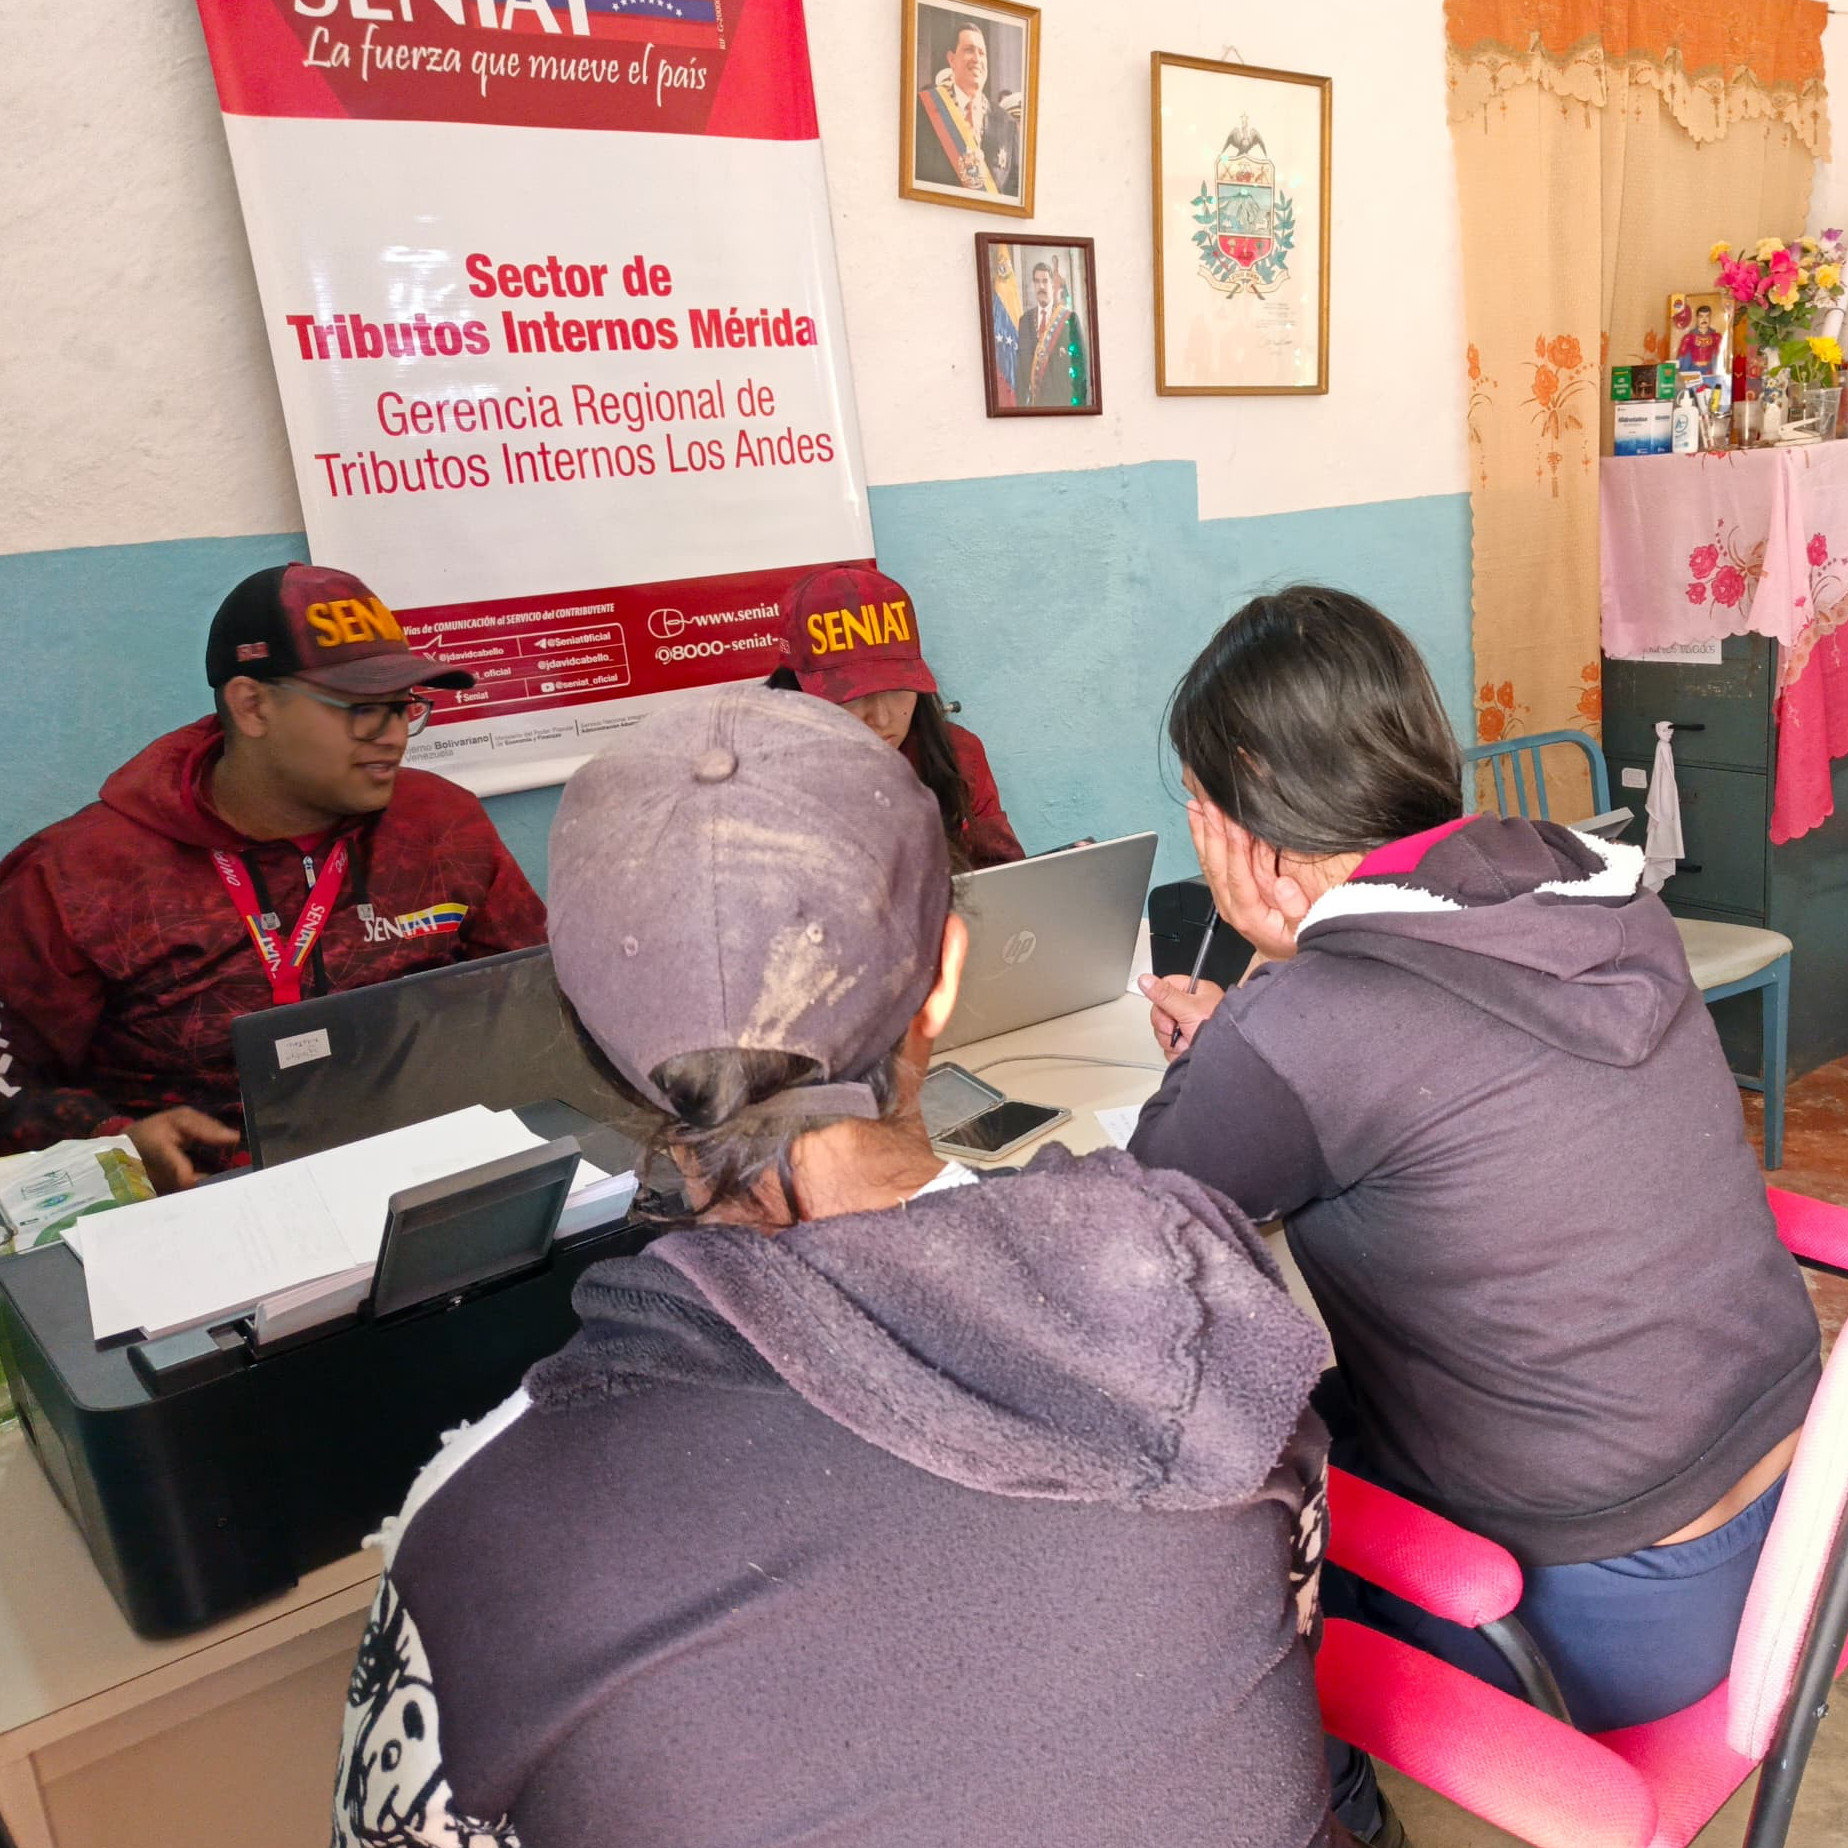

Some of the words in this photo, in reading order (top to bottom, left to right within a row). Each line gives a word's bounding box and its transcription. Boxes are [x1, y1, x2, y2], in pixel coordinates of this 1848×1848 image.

[302, 26, 351, 68] La
[361, 23, 461, 82] fuerza
[471, 51, 520, 97] que
[528, 55, 619, 84] mueve
[628, 43, 654, 85] el
[658, 57, 707, 107] país
[465, 252, 607, 298] Sector
[622, 255, 672, 297] de
[286, 313, 490, 360] Tributos
[501, 310, 678, 354] Internos
[688, 307, 817, 348] Mérida
[377, 386, 562, 437] Gerencia
[571, 379, 726, 432] Regional
[736, 378, 775, 417] de
[315, 446, 490, 498] Tributos
[501, 441, 656, 485] Internos
[666, 433, 726, 473] Los
[735, 427, 834, 469] Andes
[422, 624, 432, 635] de
[506, 611, 541, 625] SERVICIO
[555, 603, 615, 620] CONTRIBUYENTE
[807, 601, 910, 654] SENIAT
[434, 734, 489, 750] Bolivariano
[294, 903, 326, 947] SENIAT
[364, 906, 439, 942] SENIAT
